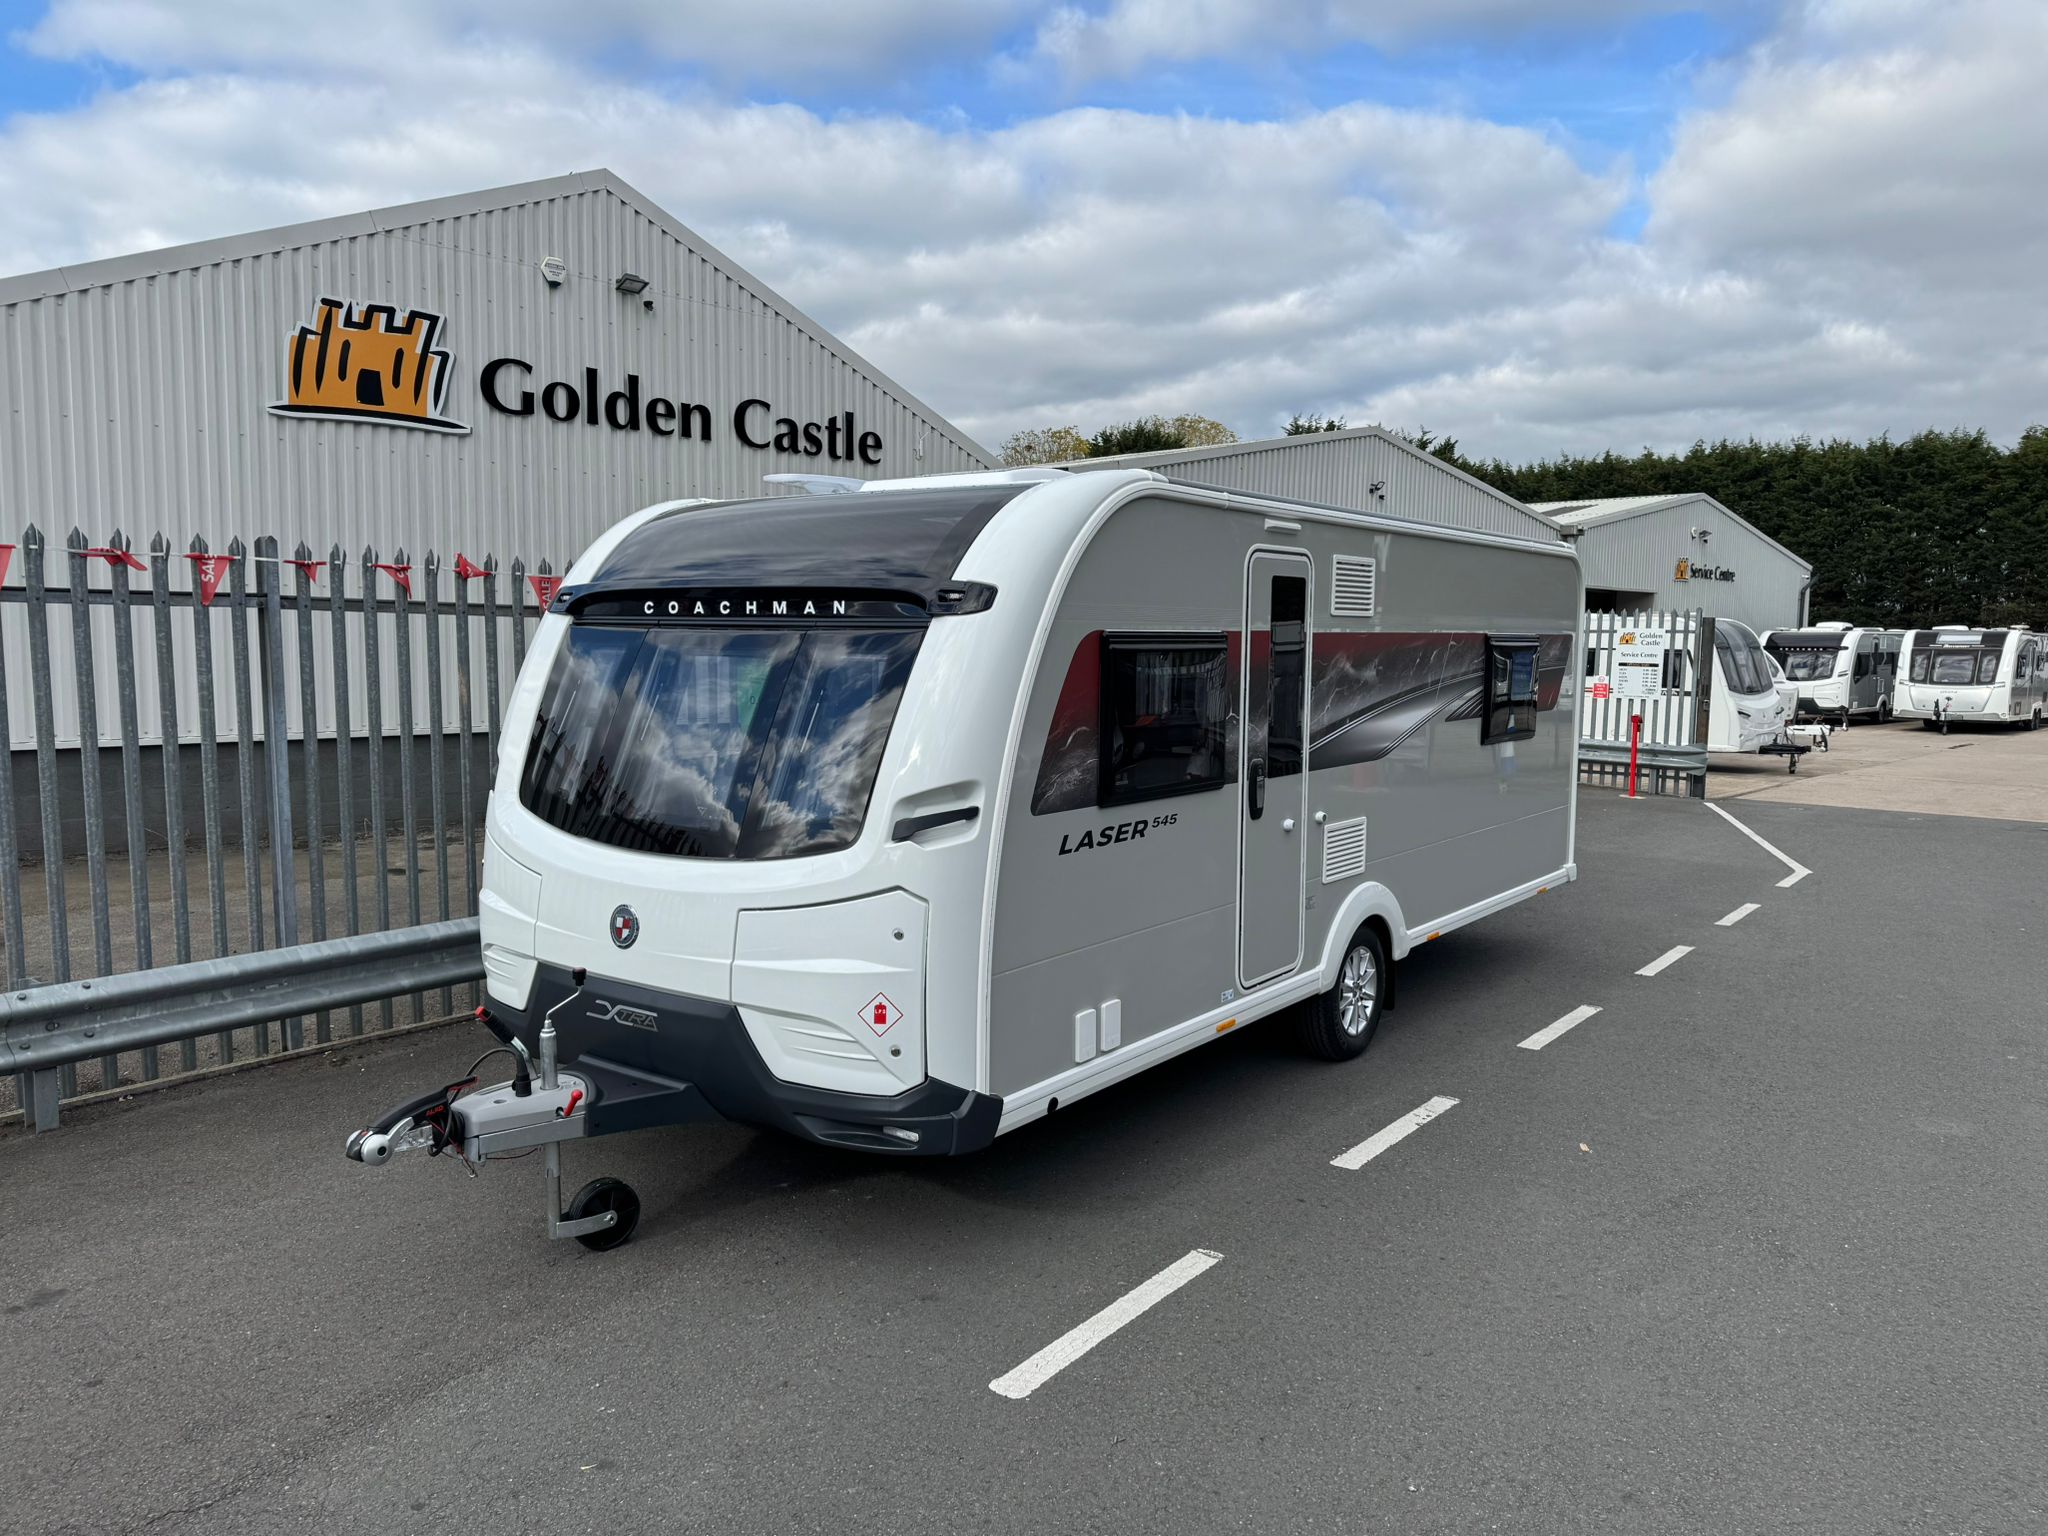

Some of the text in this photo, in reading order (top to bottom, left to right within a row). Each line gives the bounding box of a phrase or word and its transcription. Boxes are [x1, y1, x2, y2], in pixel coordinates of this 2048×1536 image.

[479, 358, 883, 465] Golden Castle
[1690, 563, 1736, 582] Service Centre
[643, 600, 846, 615] COACHMAN
[1058, 813, 1178, 856] LASER 545
[586, 999, 658, 1032] XTRA
